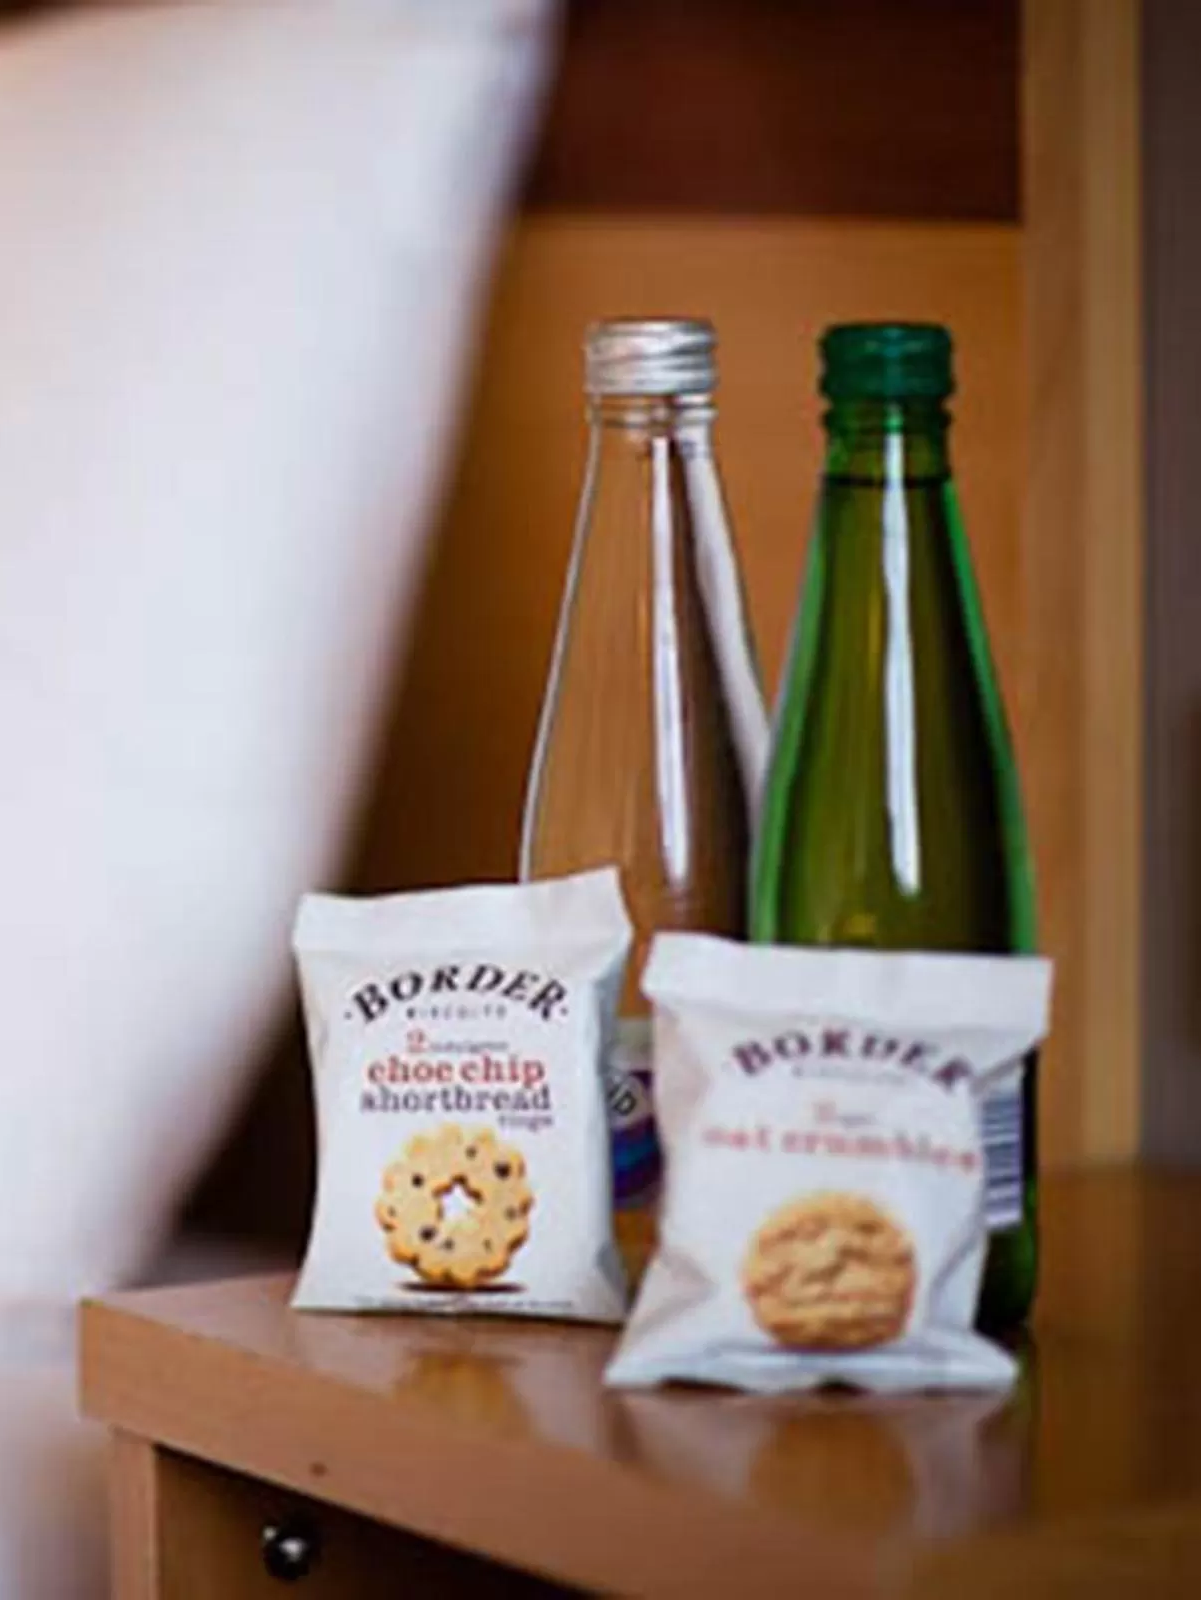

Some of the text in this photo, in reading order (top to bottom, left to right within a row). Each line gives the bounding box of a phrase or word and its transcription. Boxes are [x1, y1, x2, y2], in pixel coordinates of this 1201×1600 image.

[352, 963, 567, 1023] BORDER
[367, 1053, 546, 1090] choc chip
[360, 1082, 552, 1113] shortbread
